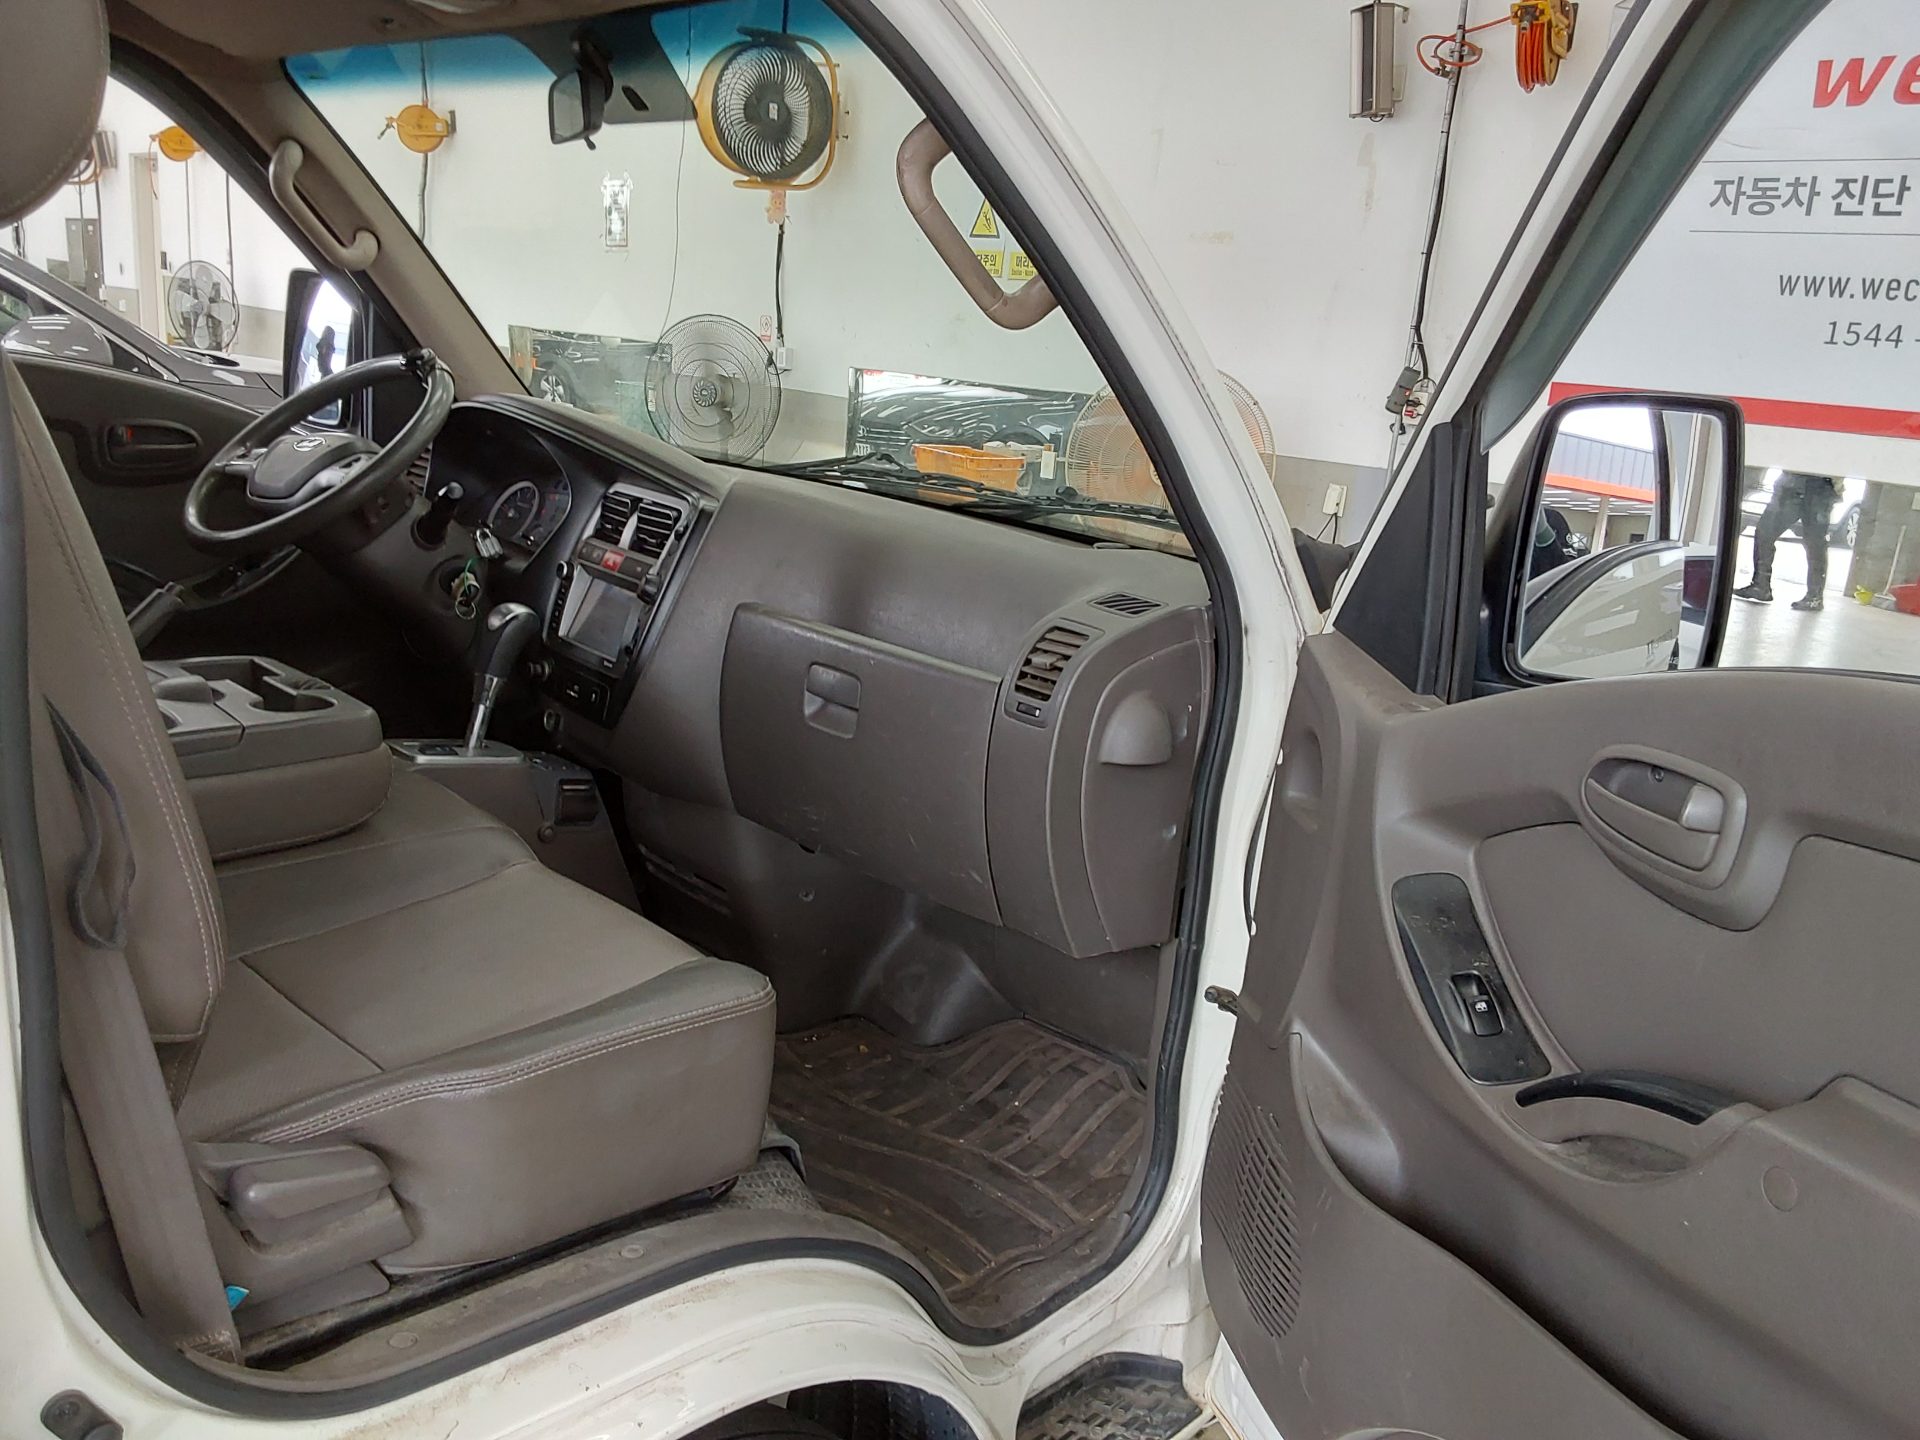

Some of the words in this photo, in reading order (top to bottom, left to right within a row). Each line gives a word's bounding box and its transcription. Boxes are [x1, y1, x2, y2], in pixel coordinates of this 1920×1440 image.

[1709, 175, 1821, 216] 자동차
[1831, 175, 1912, 217] 진단
[1779, 273, 1920, 302] www.wec
[1824, 320, 1904, 349] 1544
